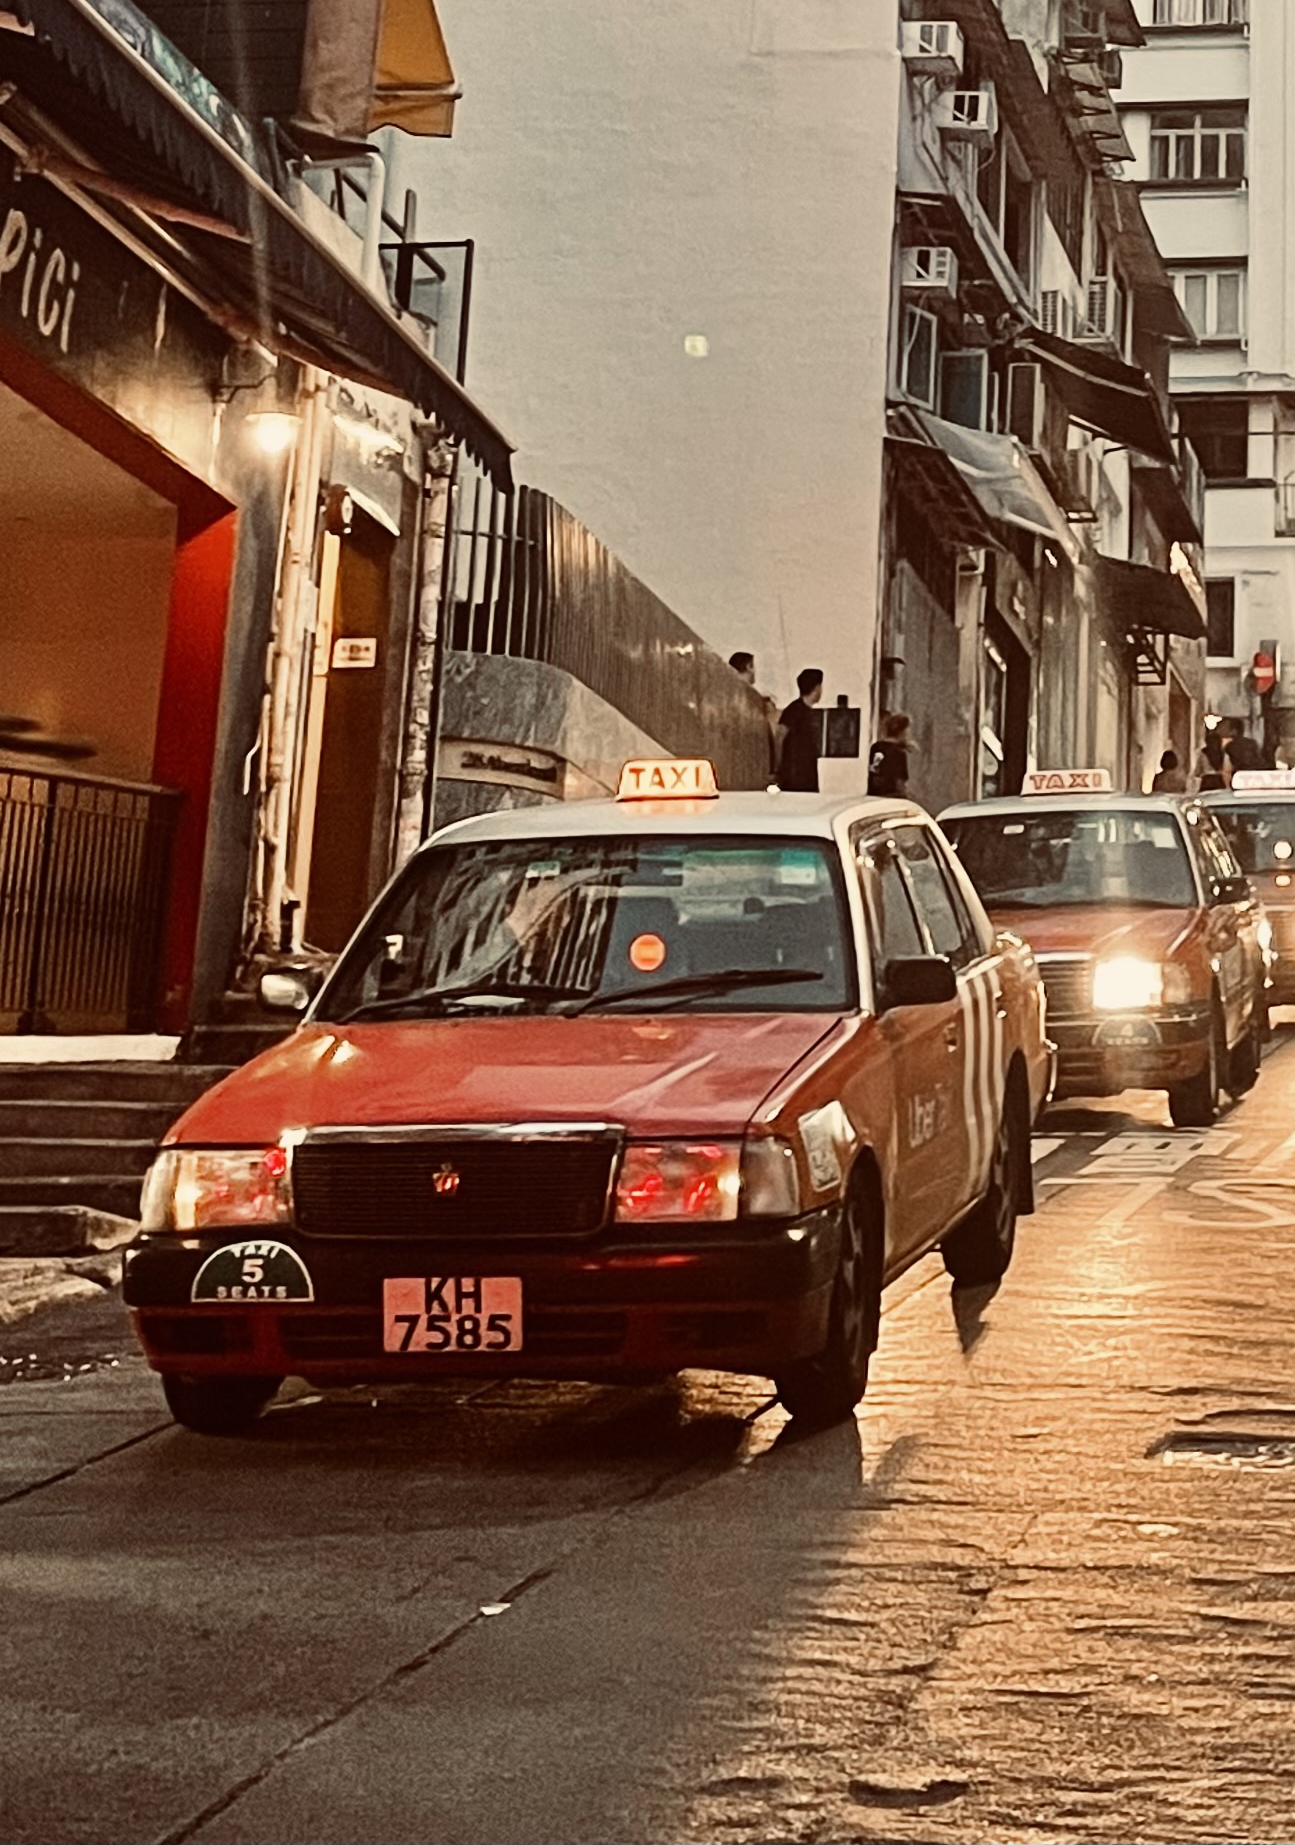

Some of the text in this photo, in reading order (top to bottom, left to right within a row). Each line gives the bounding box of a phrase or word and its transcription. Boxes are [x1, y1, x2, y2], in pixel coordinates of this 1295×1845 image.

[628, 767, 700, 790] TAXI
[1029, 773, 1102, 790] TAXI
[241, 1258, 264, 1283] 5
[216, 1285, 287, 1299] SEATS
[424, 1277, 482, 1315] KH
[394, 1314, 513, 1351] 7585
